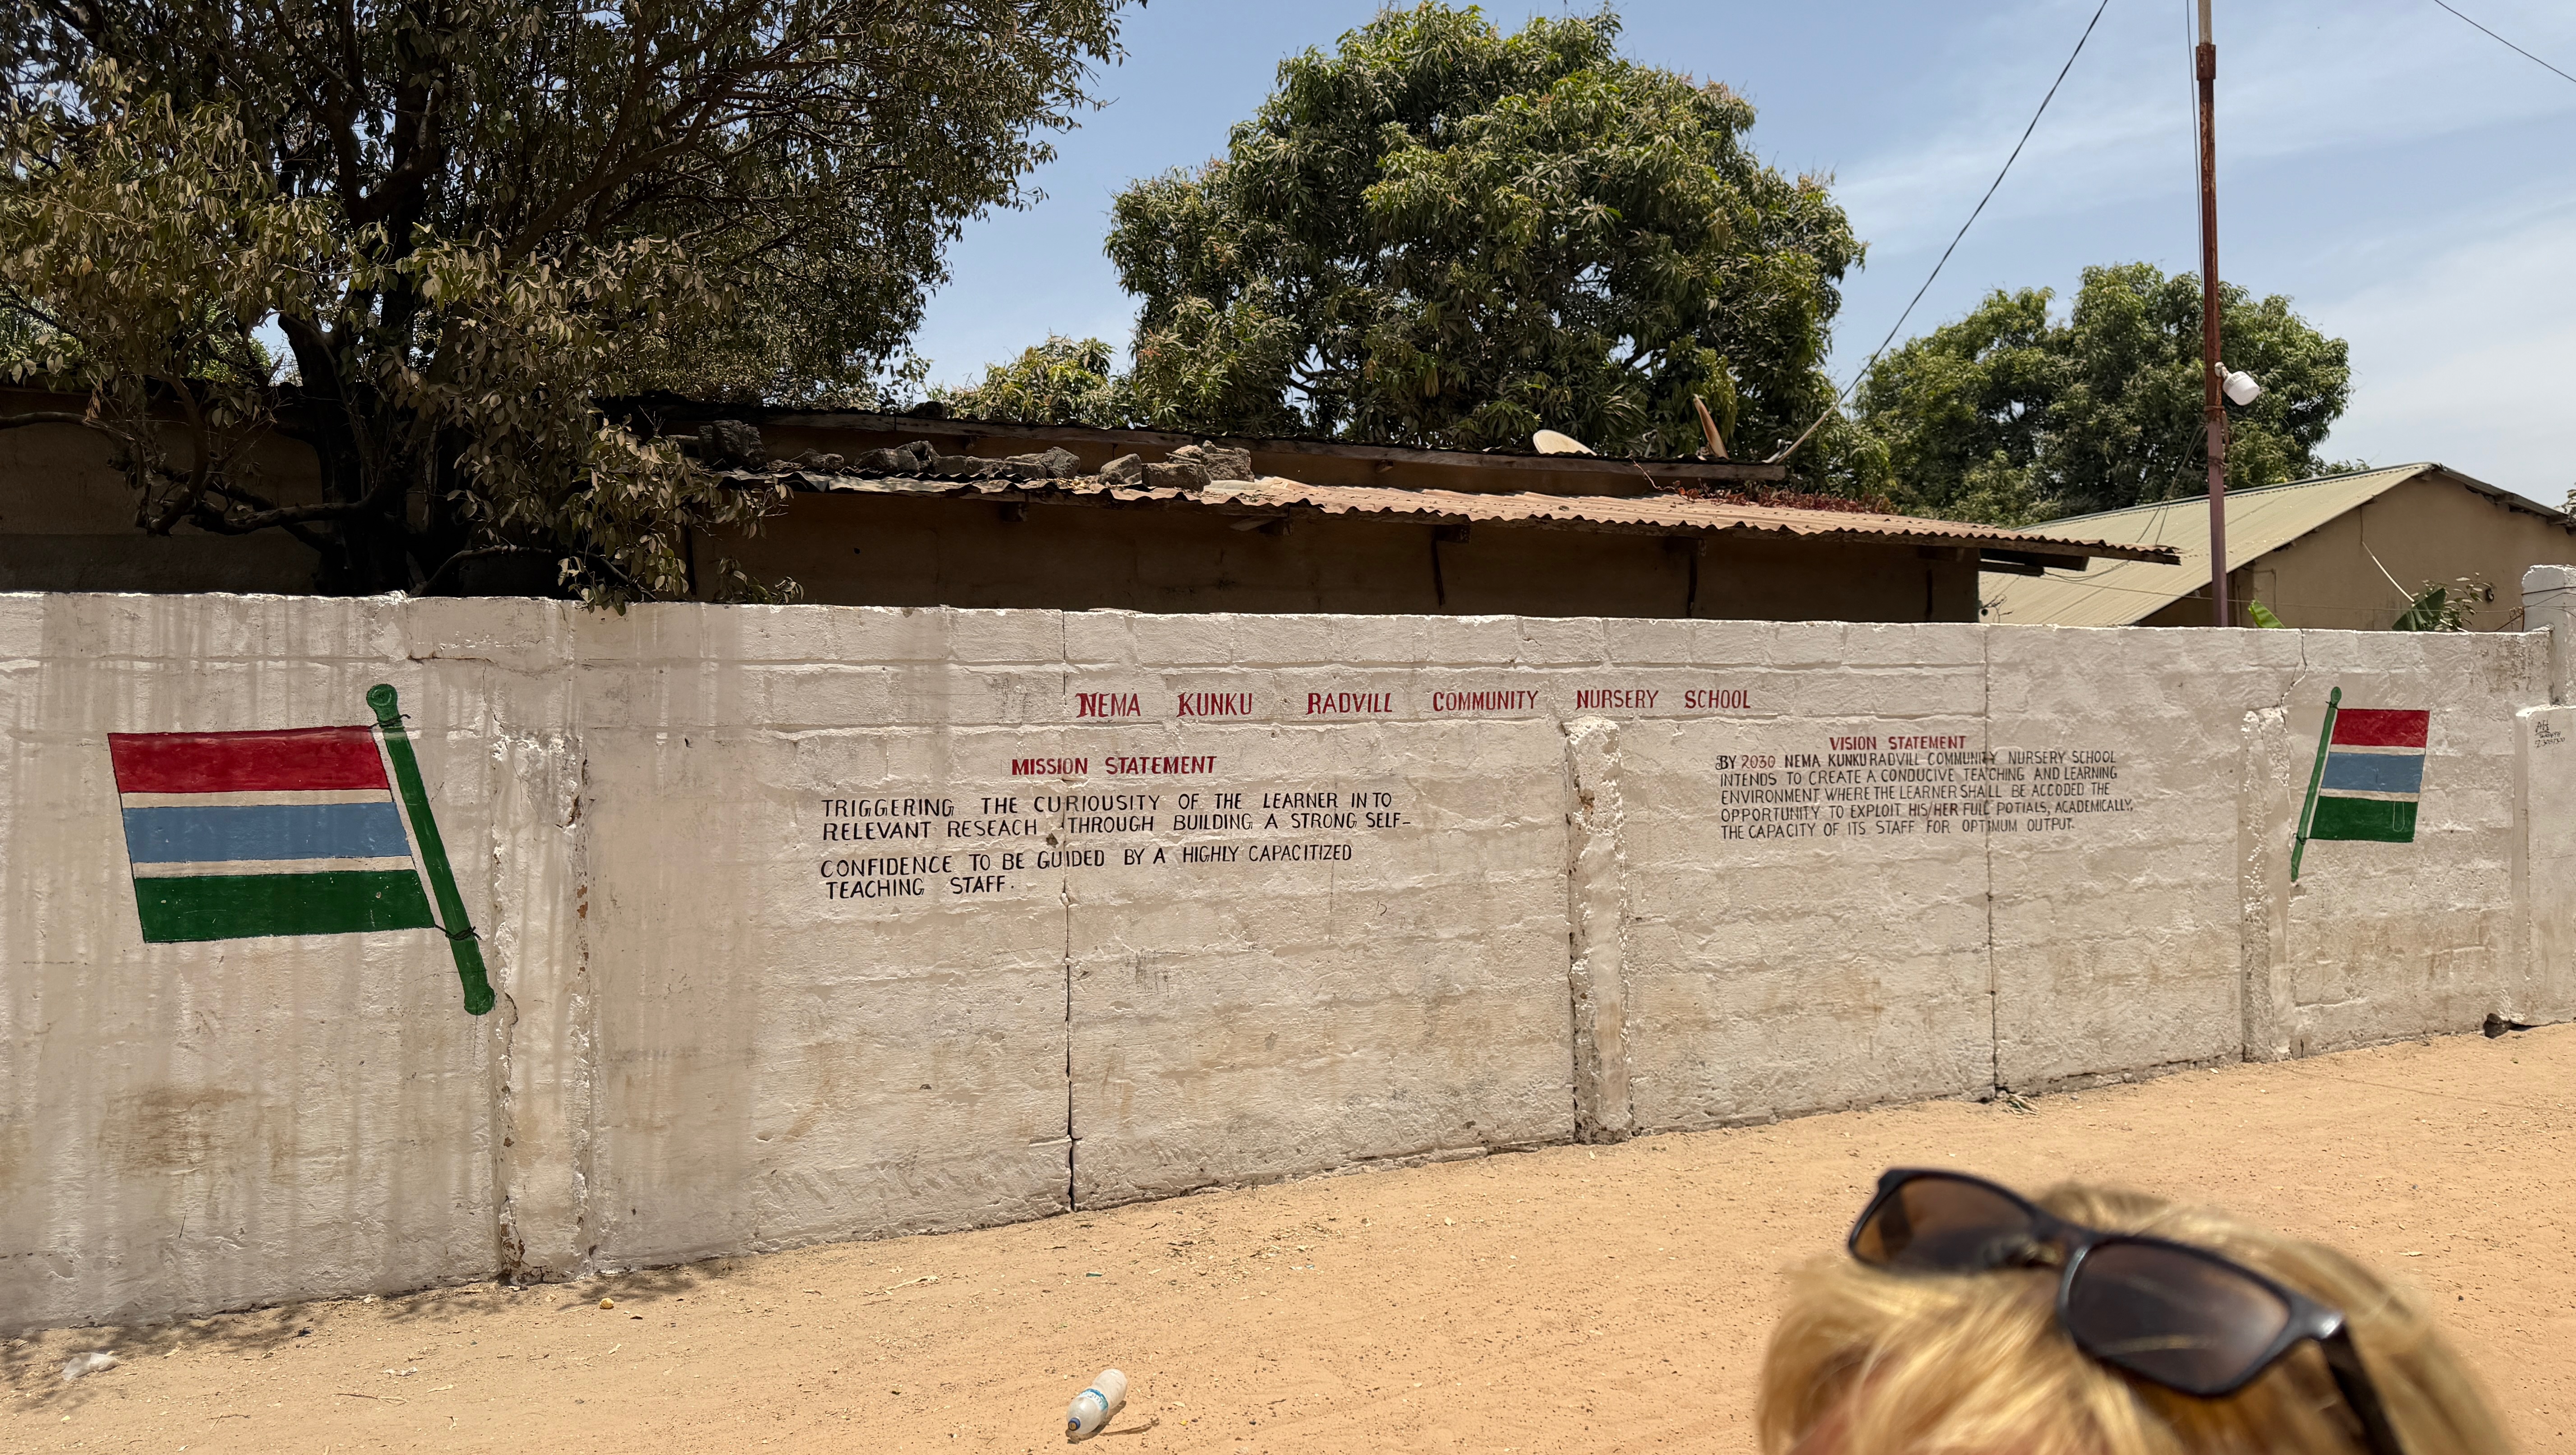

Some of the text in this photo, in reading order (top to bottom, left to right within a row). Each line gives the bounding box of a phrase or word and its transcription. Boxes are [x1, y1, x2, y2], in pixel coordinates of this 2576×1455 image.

[1075, 690, 1751, 718] NEMA KUNKU RADVILL COMMUNITY NURSERY SCHOOL
[1830, 735, 1967, 751] VISION STATEMENT
[1012, 756, 1217, 776] MISSION STATEMENT
[1715, 751, 2116, 770] BY 2030 NEMA KUNKU RADVILL COMMUNITY NURSERY SCHOOL
[1720, 766, 2118, 787] INTENDS TO CREATE A CONDUCIVE TEACHING AND LEARNING
[821, 799, 954, 817] TRIGGERING
[981, 797, 1018, 814] THE
[1034, 794, 1160, 812] CURIOUSITY
[1178, 793, 1200, 810] OF
[1214, 793, 1242, 809] THE
[1263, 792, 1339, 808] LEARNER
[1721, 782, 2110, 805] ENVIRONMENT WHERE THE LEARNER SHALL BE ACCODED THE
[1721, 805, 1821, 822] OPPORTUNITY
[1828, 805, 1844, 819] TO
[1850, 803, 1901, 818] EXPLOIT
[1909, 802, 1959, 821] HIS/HER
[1963, 800, 1990, 816] FULL
[1996, 802, 2051, 817] POTIALS,
[823, 812, 1411, 841] RELEVANT RESEACH THROUGH BUILDING A STRONG SELF-
[1721, 817, 2075, 840] THE CAPACITY OF ITS STAFF FOR OPTIMUM OUTPUT.
[821, 844, 1352, 878] CONFIDENCE TO BE GUIDED BY A HIGHLY CAPACITIZED
[826, 878, 925, 900] TEACHING
